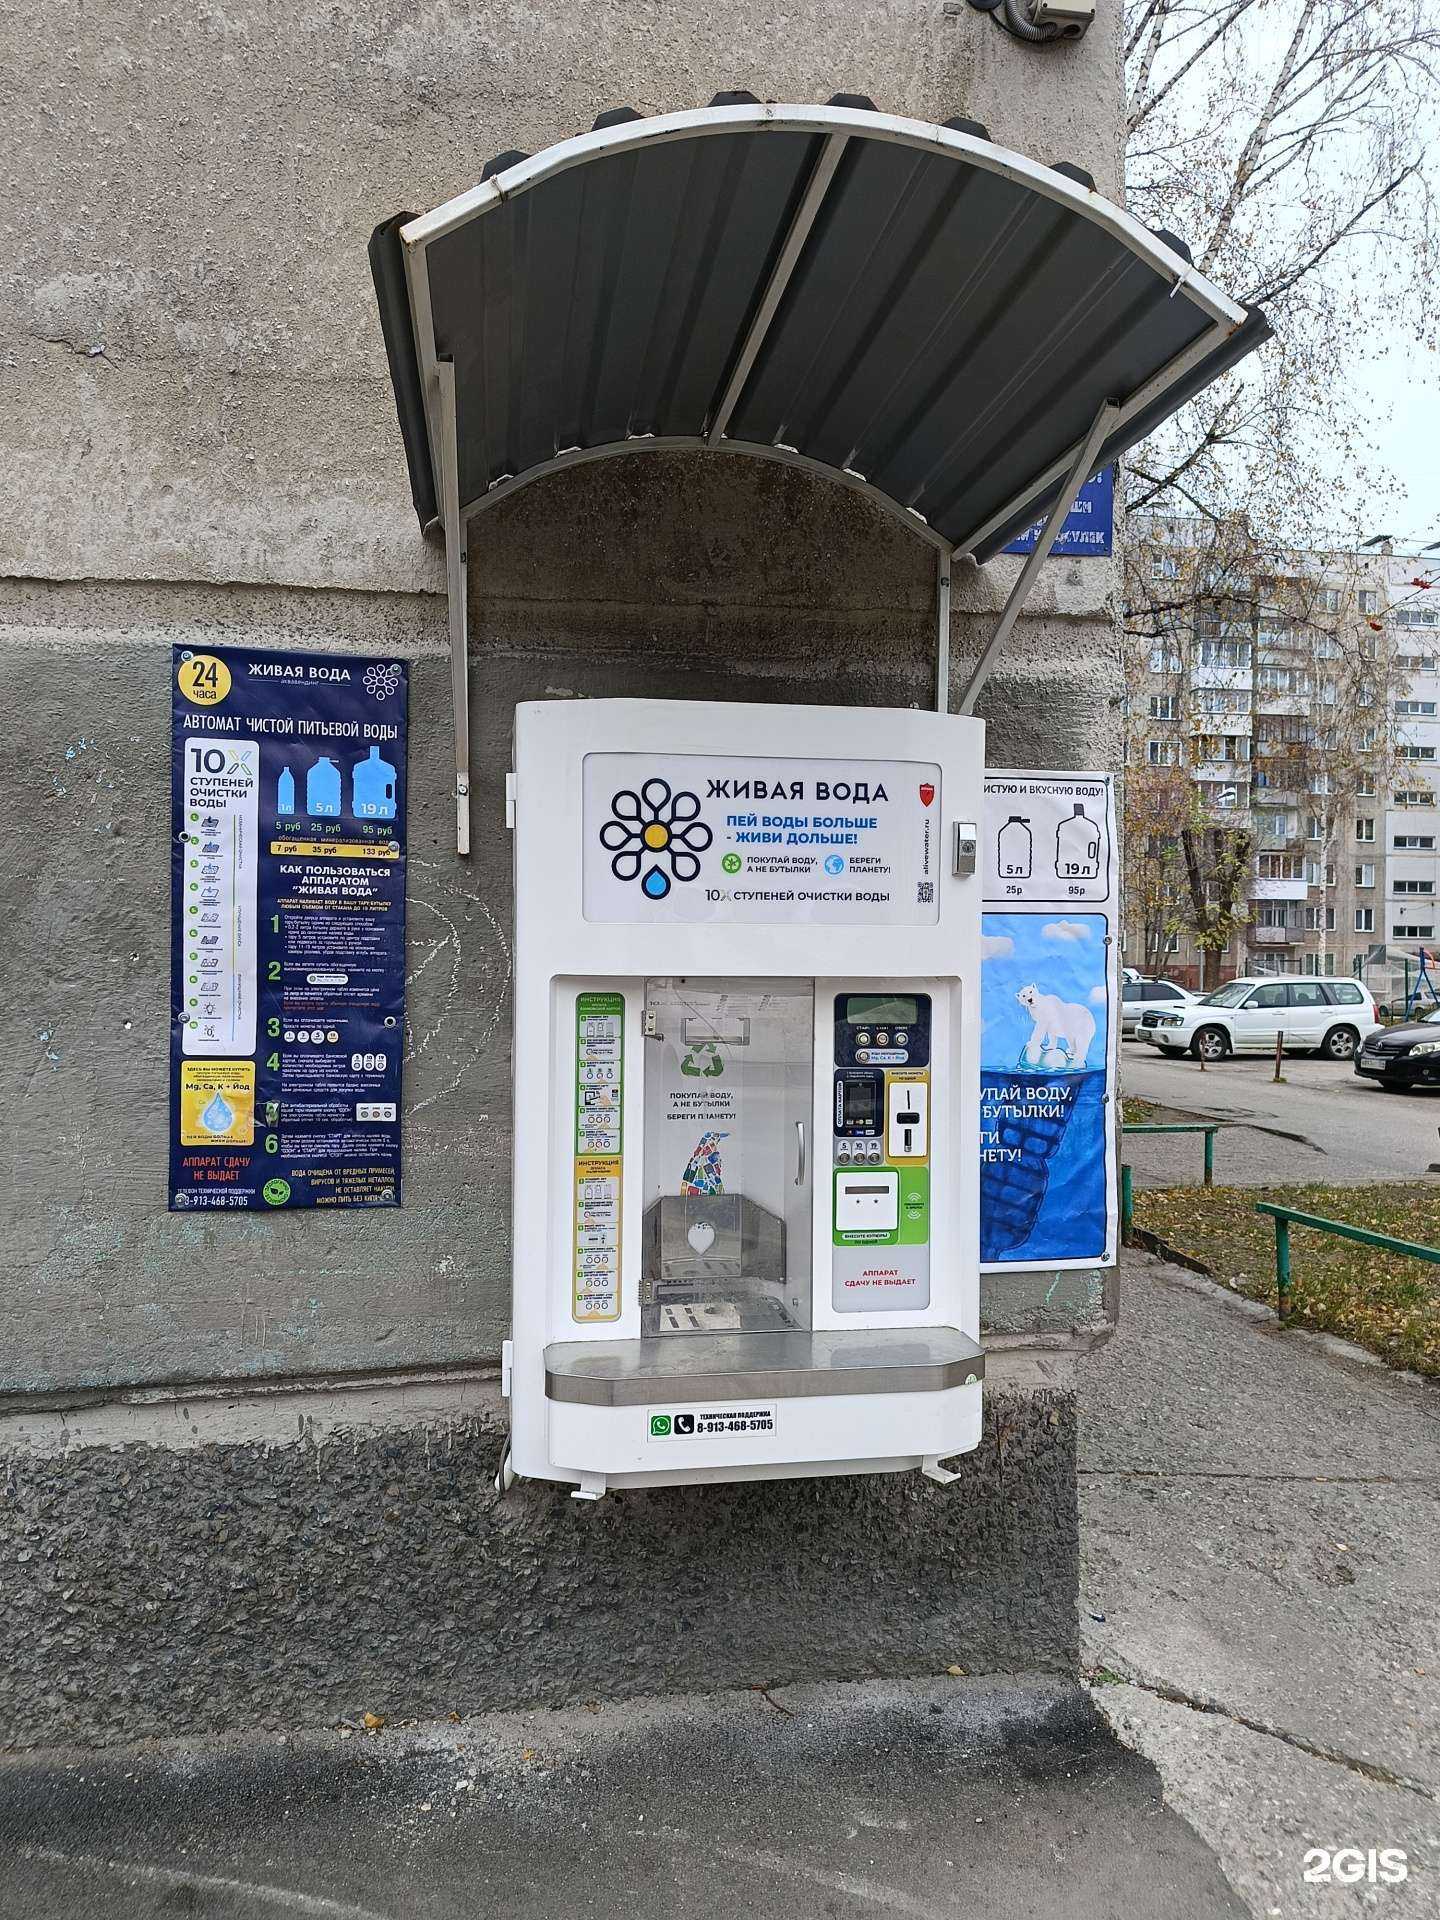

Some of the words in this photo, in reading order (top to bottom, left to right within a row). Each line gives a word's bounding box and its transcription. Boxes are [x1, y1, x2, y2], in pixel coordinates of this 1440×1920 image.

[193, 661, 218, 687] 24
[248, 664, 303, 678] ЖИВАЯ
[309, 667, 351, 681] ВОДА
[193, 690, 217, 699] часа
[183, 714, 241, 731] АВТОМАТ
[246, 717, 293, 734] ЧИСТОЙ
[298, 720, 359, 737] ПИТЬЕВОЙ
[364, 724, 398, 741] ВОДЫ
[190, 777, 253, 788] СТУПЕНЕЙ
[190, 788, 247, 798] ОЧИСТКИ
[706, 780, 804, 800] ЖИВАЯ
[816, 782, 889, 804] ВОДА
[1020, 785, 1026, 793] И
[1029, 786, 1073, 795] ВКУСНУЮ
[1076, 787, 1104, 797] ВОДУ!
[190, 799, 226, 808] ВОДЫ
[726, 813, 757, 827] ПЕЙ
[762, 816, 808, 829] ВОДЫ
[813, 817, 877, 828] БОЛЬШЕ
[276, 822, 281, 830] 5
[285, 822, 301, 832] руб
[311, 823, 322, 831] 25
[326, 824, 341, 833] руб
[363, 825, 374, 834] 95
[377, 826, 392, 836] руб
[736, 832, 782, 844] ЖИВИ
[786, 833, 857, 845] ДОЛЬШЕ!
[284, 845, 297, 854] руб
[324, 846, 337, 855] руб
[747, 856, 789, 864] ПОКУПАЙ
[792, 857, 818, 865] ВОДУ,
[280, 865, 302, 874] КАК
[306, 866, 391, 877] ПОЛЬЗОВАТЬСЯ
[302, 876, 369, 886] АППАРАТОМ
[733, 891, 794, 901] СТУПЕНЕЙ
[798, 892, 852, 901] ОЧИСТКИ
[856, 893, 890, 902] ВОДЫ
[271, 915, 279, 933] 1
[268, 961, 280, 980] 2
[268, 1018, 280, 1036] 3
[266, 1053, 280, 1071] 4
[233, 1082, 250, 1090] Йод
[1026, 1087, 1072, 1102] ВОДУ,
[983, 1105, 1064, 1118] БУТЫЛКИ!
[265, 1134, 278, 1154] 6
[183, 1157, 220, 1167] АППАРАТ
[224, 1157, 250, 1167] СДАЧУ
[194, 1171, 204, 1180] НЕ
[208, 1171, 240, 1181] ВЫДАЕТ
[308, 1169, 333, 1177] ОЧИЩЕНА
[697, 1419, 773, 1433] 8-913-468-5705
